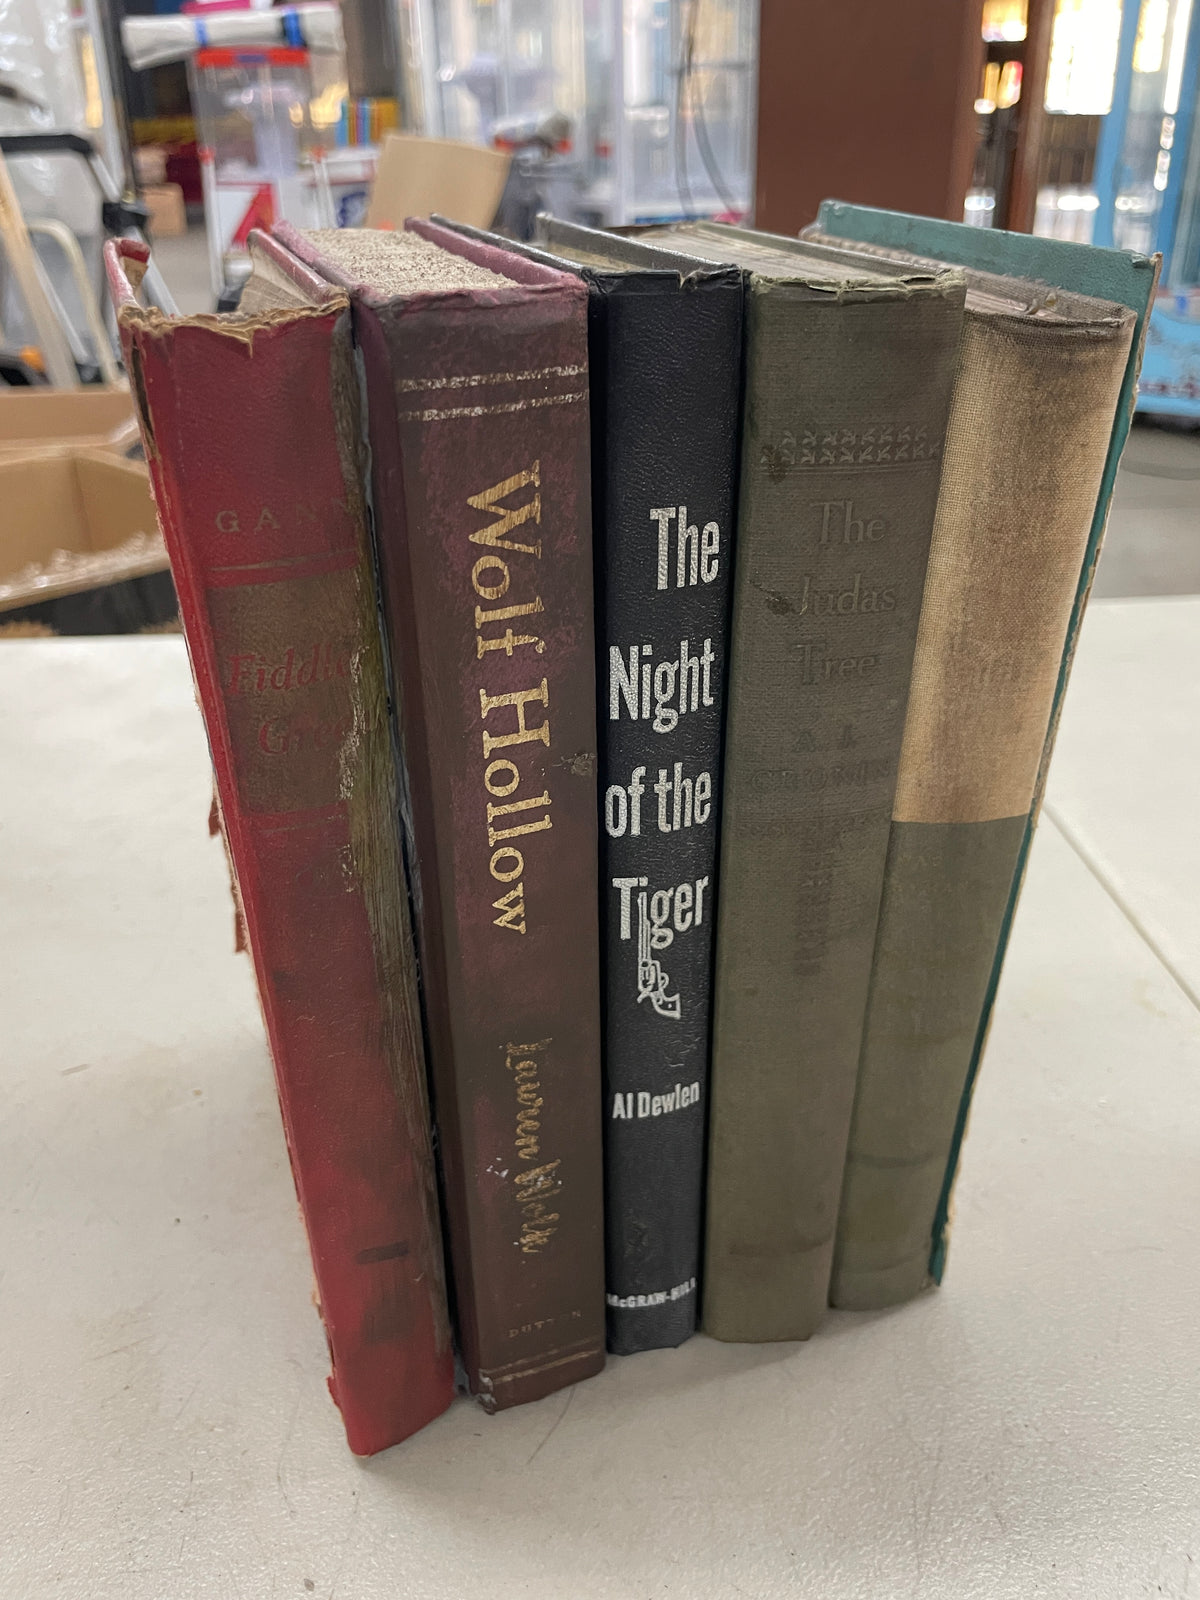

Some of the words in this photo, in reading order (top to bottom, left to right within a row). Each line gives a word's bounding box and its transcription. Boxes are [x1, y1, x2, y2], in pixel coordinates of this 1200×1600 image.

[467, 459, 546, 660] Wolf
[649, 505, 720, 590] The
[810, 500, 886, 545] The
[799, 572, 896, 616] Judas
[609, 637, 715, 734] Night
[796, 643, 876, 686] Tree
[479, 677, 553, 935] Hollow
[604, 765, 646, 838] of
[653, 762, 712, 833] the
[612, 875, 709, 958] Tiger
[504, 1037, 553, 1161] Lauren
[612, 1092, 634, 1119] Al
[637, 1081, 700, 1118] Dewlen
[508, 1309, 583, 1338] DUTTN
